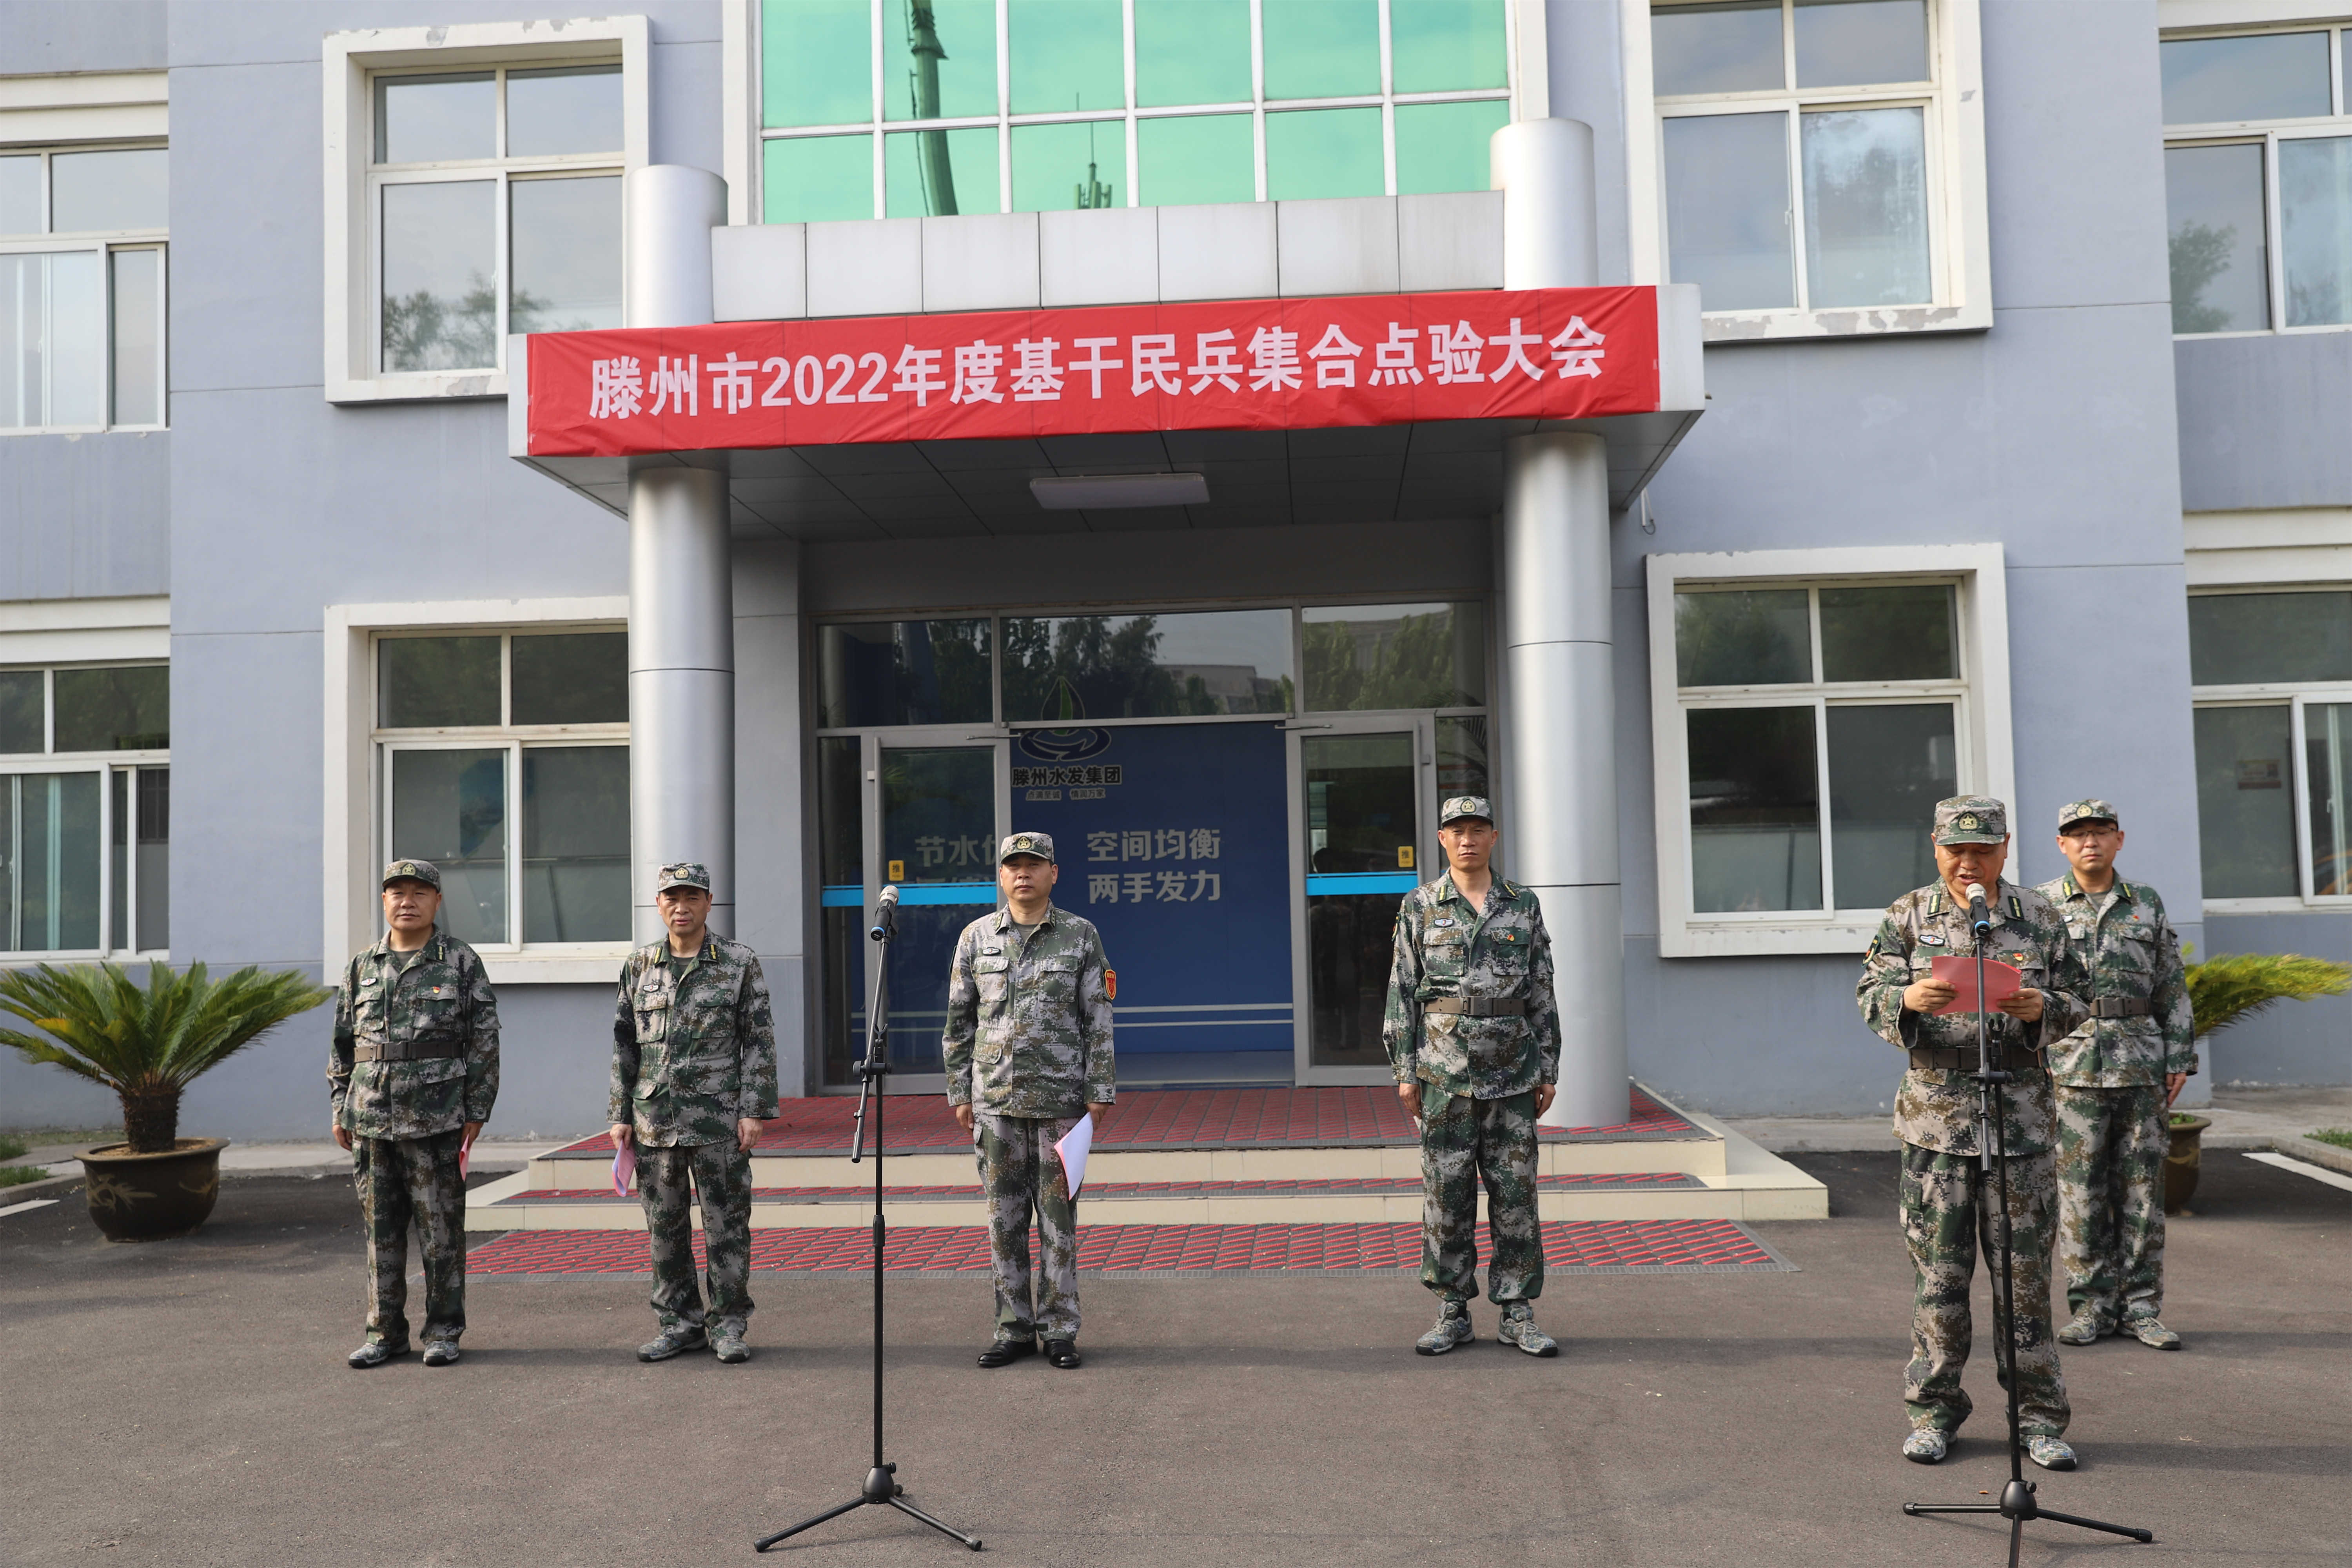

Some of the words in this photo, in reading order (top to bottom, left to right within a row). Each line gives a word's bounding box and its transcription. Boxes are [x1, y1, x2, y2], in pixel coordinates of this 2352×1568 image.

[589, 316, 1606, 419] 滕州市2022年度基干民兵集合点验大会
[1012, 766, 1121, 786] 滕州水发集团
[1087, 828, 1221, 862] 空间均衡
[1088, 870, 1221, 904] 两手发力
